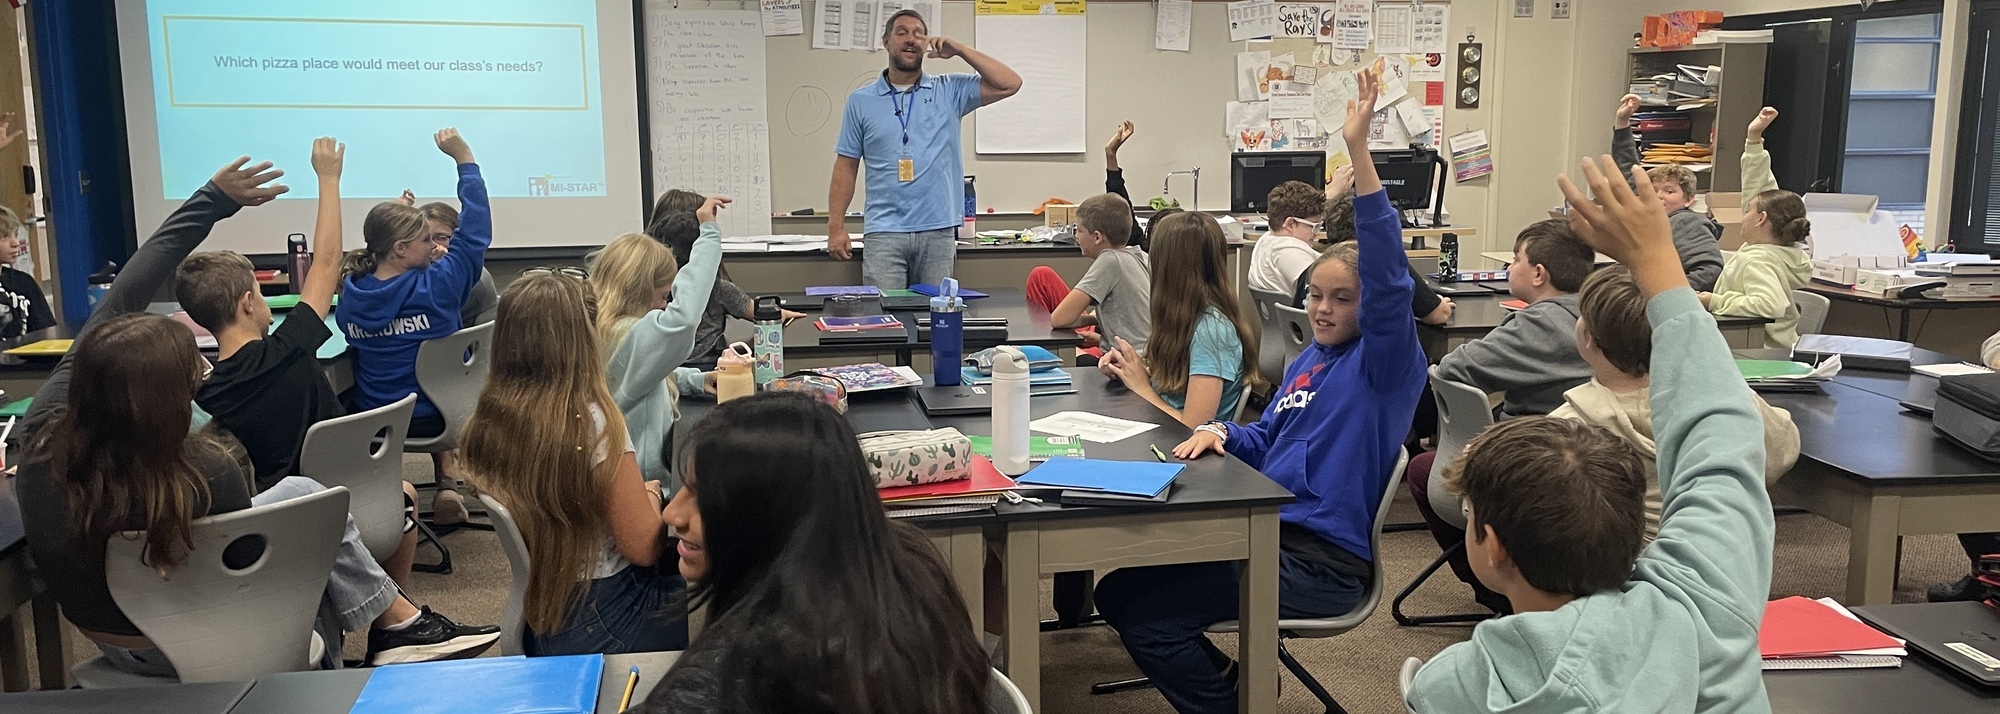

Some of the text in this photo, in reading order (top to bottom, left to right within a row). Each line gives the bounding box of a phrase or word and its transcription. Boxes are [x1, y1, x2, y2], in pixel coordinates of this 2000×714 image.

[1279, 6, 1301, 22] Save
[1302, 9, 1314, 23] the
[214, 56, 543, 72] Which pizza place would meet our class's needs?
[551, 183, 598, 193] MI-STAR
